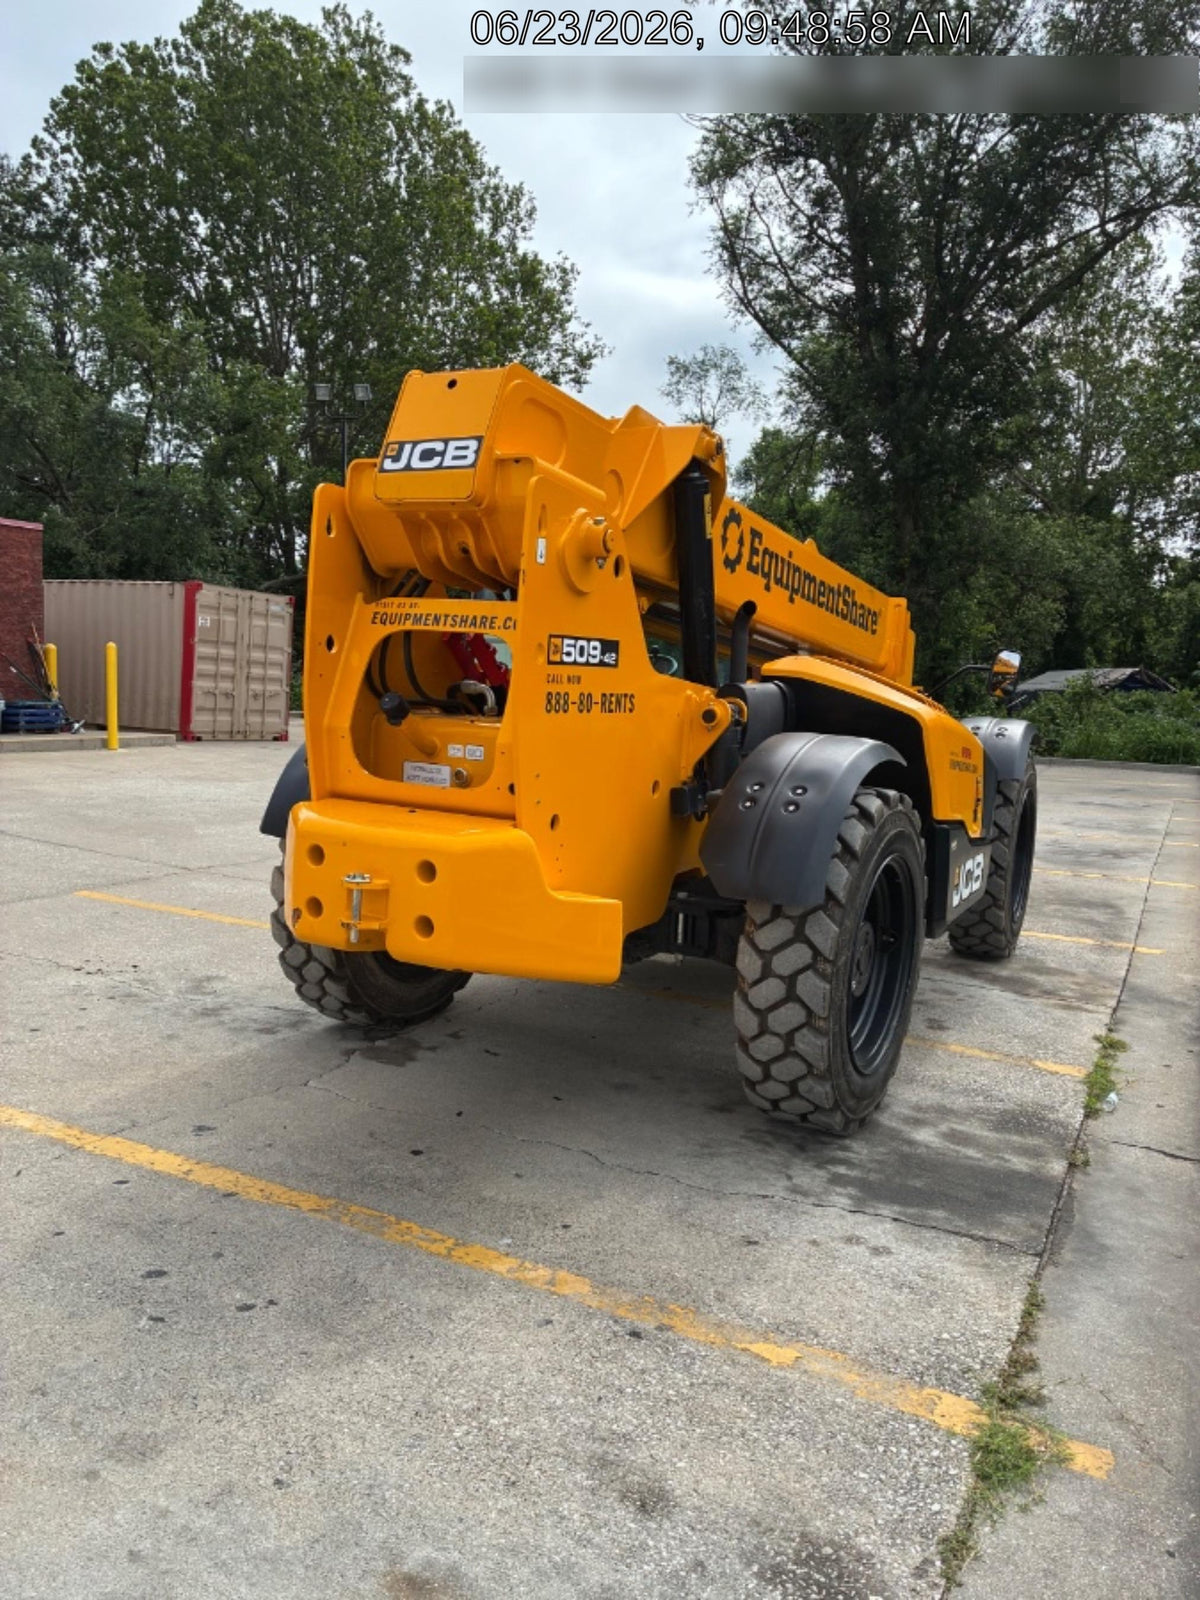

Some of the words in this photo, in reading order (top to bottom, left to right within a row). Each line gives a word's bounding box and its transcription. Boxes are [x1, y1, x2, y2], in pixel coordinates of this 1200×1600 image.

[383, 439, 479, 470] JCB
[746, 526, 879, 635] EquipmentShare
[547, 673, 563, 684] CALL
[567, 675, 582, 685] NOW
[545, 691, 635, 714] 888-80-RENTS
[952, 852, 985, 908] JCB
